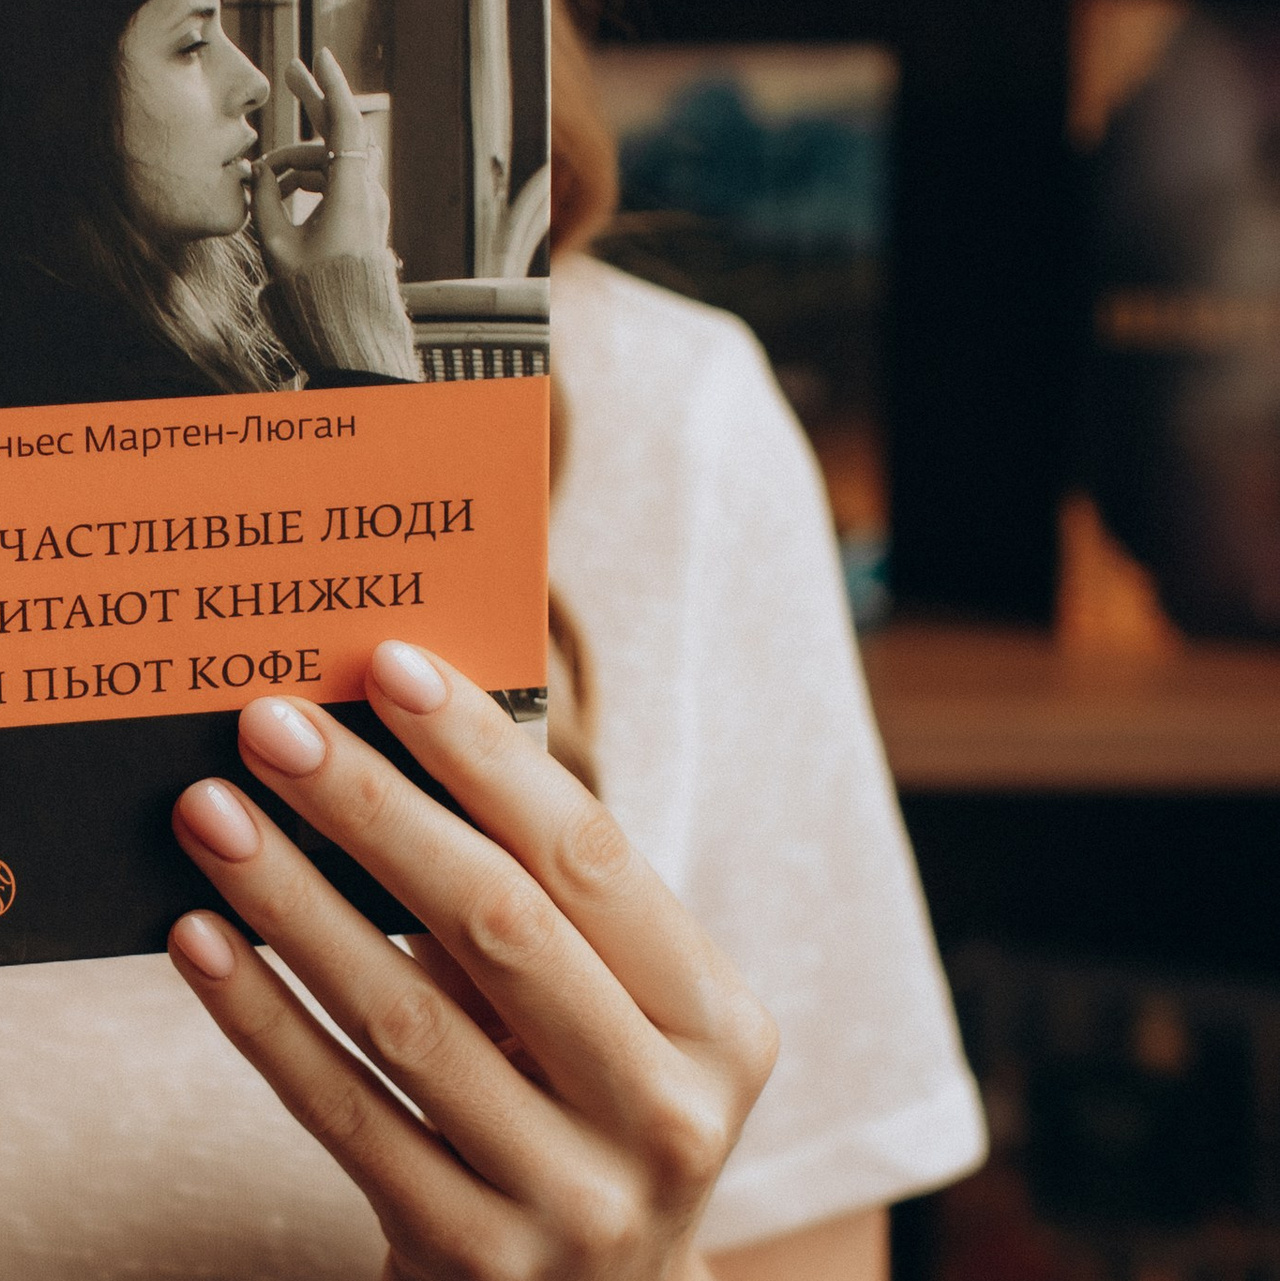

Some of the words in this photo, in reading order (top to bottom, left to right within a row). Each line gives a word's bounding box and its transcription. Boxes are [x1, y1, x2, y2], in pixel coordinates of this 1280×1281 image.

[84, 413, 356, 458] Мартен-Люган
[320, 498, 475, 543] ЛЮДИ
[194, 572, 424, 620] КНИЖКИ
[23, 658, 173, 703] ПЬЮТ
[188, 648, 322, 691] КОФЕ
